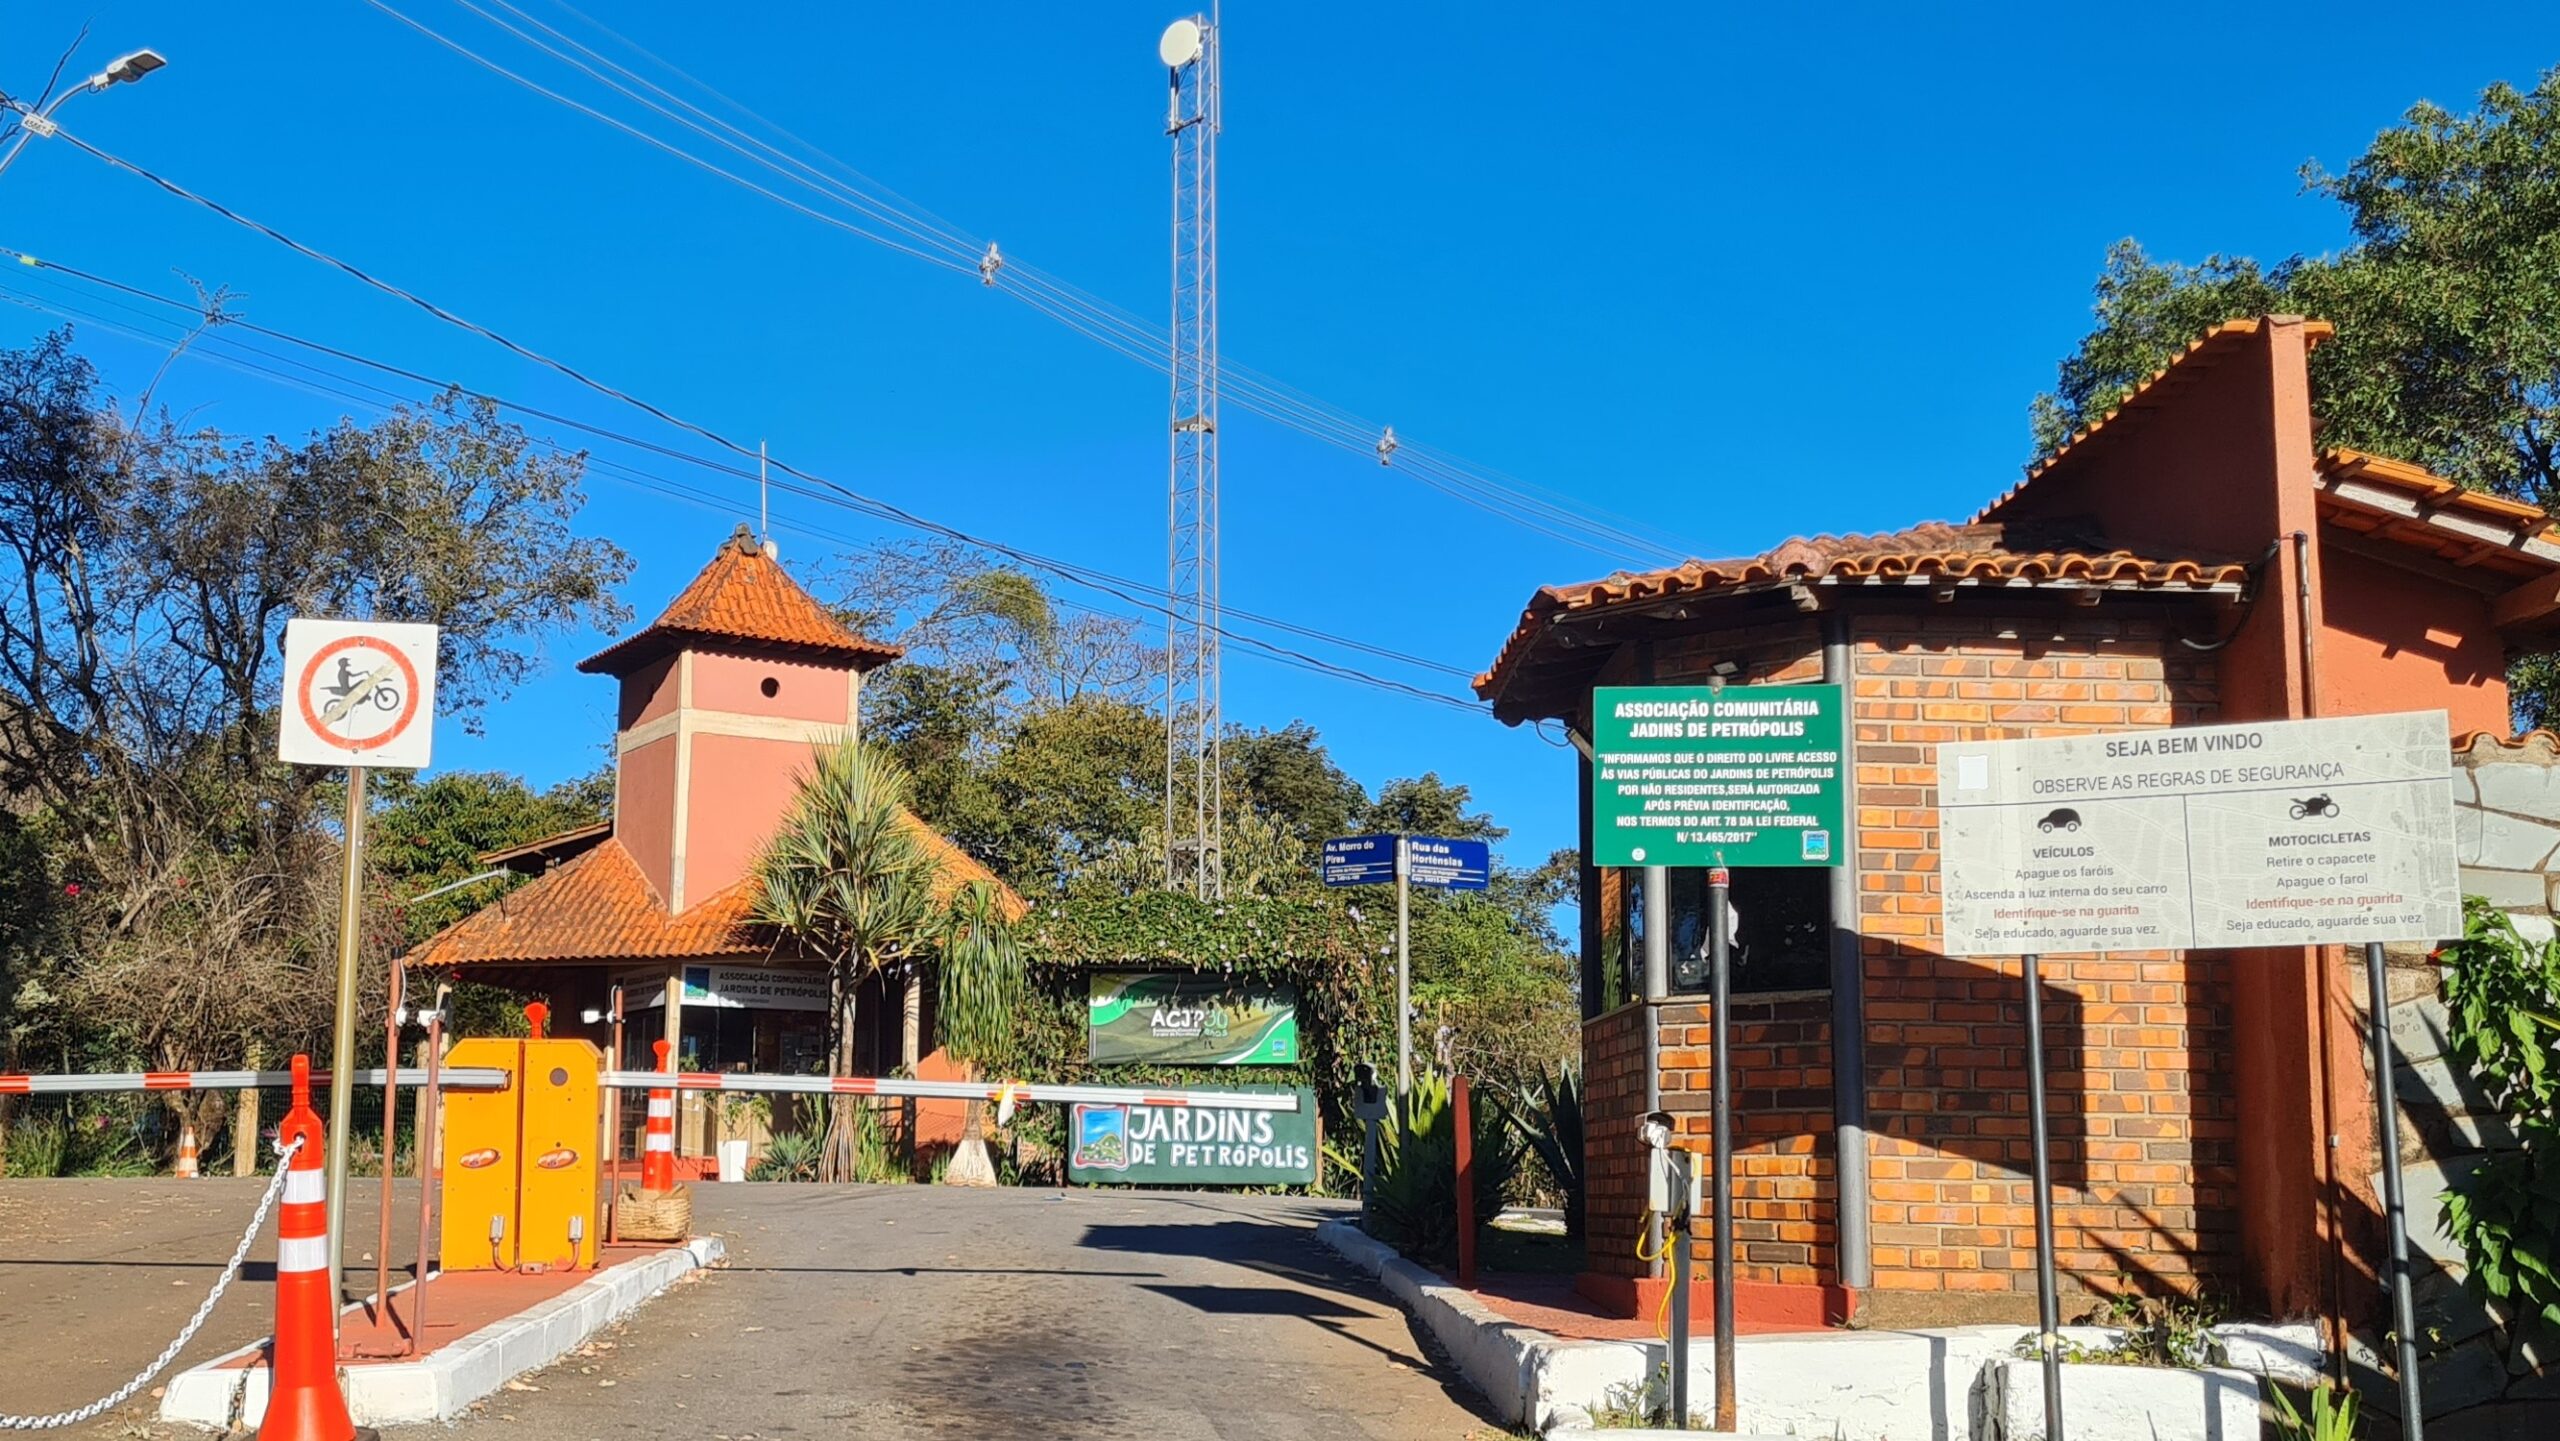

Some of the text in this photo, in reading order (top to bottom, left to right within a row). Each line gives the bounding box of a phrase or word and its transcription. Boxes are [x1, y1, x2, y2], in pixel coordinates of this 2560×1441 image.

[1615, 698, 1819, 720] ASSOCIAÇÃO COMUNITÁRIA
[1629, 720, 1805, 737] JADINS DE PETRÓPOLIS
[2106, 732, 2263, 757] SEJA BEM VINDO
[1674, 753, 1695, 764] QUE
[1696, 753, 1705, 763] O
[1706, 753, 1746, 763] DIREITO
[1748, 753, 1763, 763] DO
[1765, 753, 1795, 763] LIVRE
[1796, 752, 1837, 763] ACESSO
[1617, 769, 1640, 779] VIAS
[1642, 767, 1690, 779] PÚBLICAS
[1693, 769, 1708, 779] DO
[1709, 768, 1754, 779] JARDINS
[1755, 768, 1770, 778] DE
[1771, 766, 1834, 779] PETRÓPOLIS
[2032, 762, 2345, 795] OBSERVE AS REGRAS DE SEGURANÇA
[1618, 785, 1639, 795] POR
[1641, 783, 1662, 795] NÃO
[1756, 784, 1820, 794] AUTORIZADA
[1644, 798, 1671, 811] APÓS
[1674, 798, 1710, 811] PRÉVIA
[1616, 816, 1819, 826] NOS TERMOS DO ART. 78 DA LEI FEDERAL
[1339, 842, 1362, 850] Morro
[1363, 840, 1375, 850] do
[2268, 831, 2371, 847] MOTOCICLETAS
[1412, 841, 1449, 854] Rua das
[2033, 846, 2095, 858] VEÍCULOS
[1325, 856, 1346, 864] Pires
[2266, 853, 2376, 868] Retire o capacete
[2015, 865, 2114, 881] Apague os faróis
[2276, 872, 2368, 890] Apague o farol
[1964, 885, 2168, 900] Ascenda a luz interna do seu carro
[2246, 891, 2403, 909] Identifique-se na guarita
[1994, 904, 2140, 920] Identifique-se na guarita
[2226, 914, 2425, 933] Seja educado, aguarde sua vez.
[1974, 925, 2160, 941] Seja educado, aguarde sua vez.
[719, 972, 826, 986] ASSOCIAÇÃO COMUNITÁRIA
[719, 984, 828, 999] JARDINS DE PETRÓPOLIS
[1131, 1142, 1156, 1165] DE
